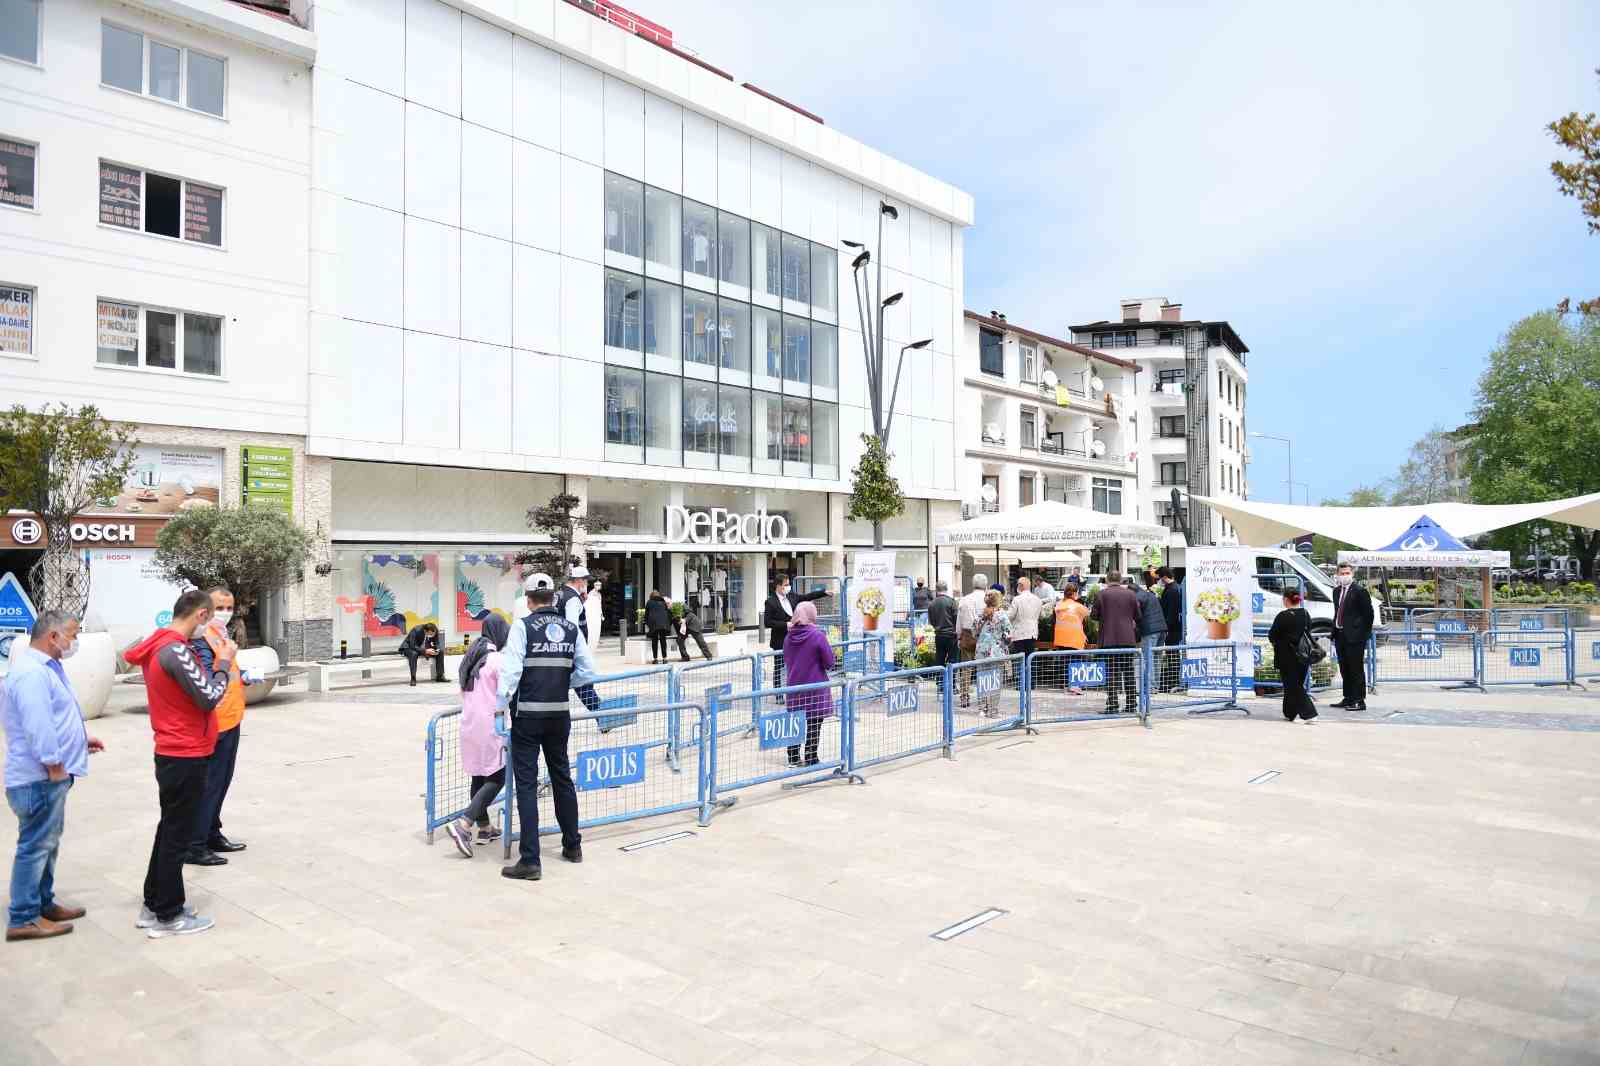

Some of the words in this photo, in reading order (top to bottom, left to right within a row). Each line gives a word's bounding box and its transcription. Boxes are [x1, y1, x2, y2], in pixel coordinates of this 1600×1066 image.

[54, 523, 136, 541] OSCH
[666, 504, 788, 544] DeFacto
[531, 642, 576, 653] ZABITA
[1411, 640, 1441, 656] POLİS
[1514, 649, 1538, 663] POLİS
[1070, 662, 1104, 682] POLİS
[1182, 659, 1208, 678] POLİS
[978, 669, 1000, 692] POLİS
[889, 687, 917, 712] POLİS
[764, 713, 800, 741] POLİS
[586, 747, 637, 782] POLİS
